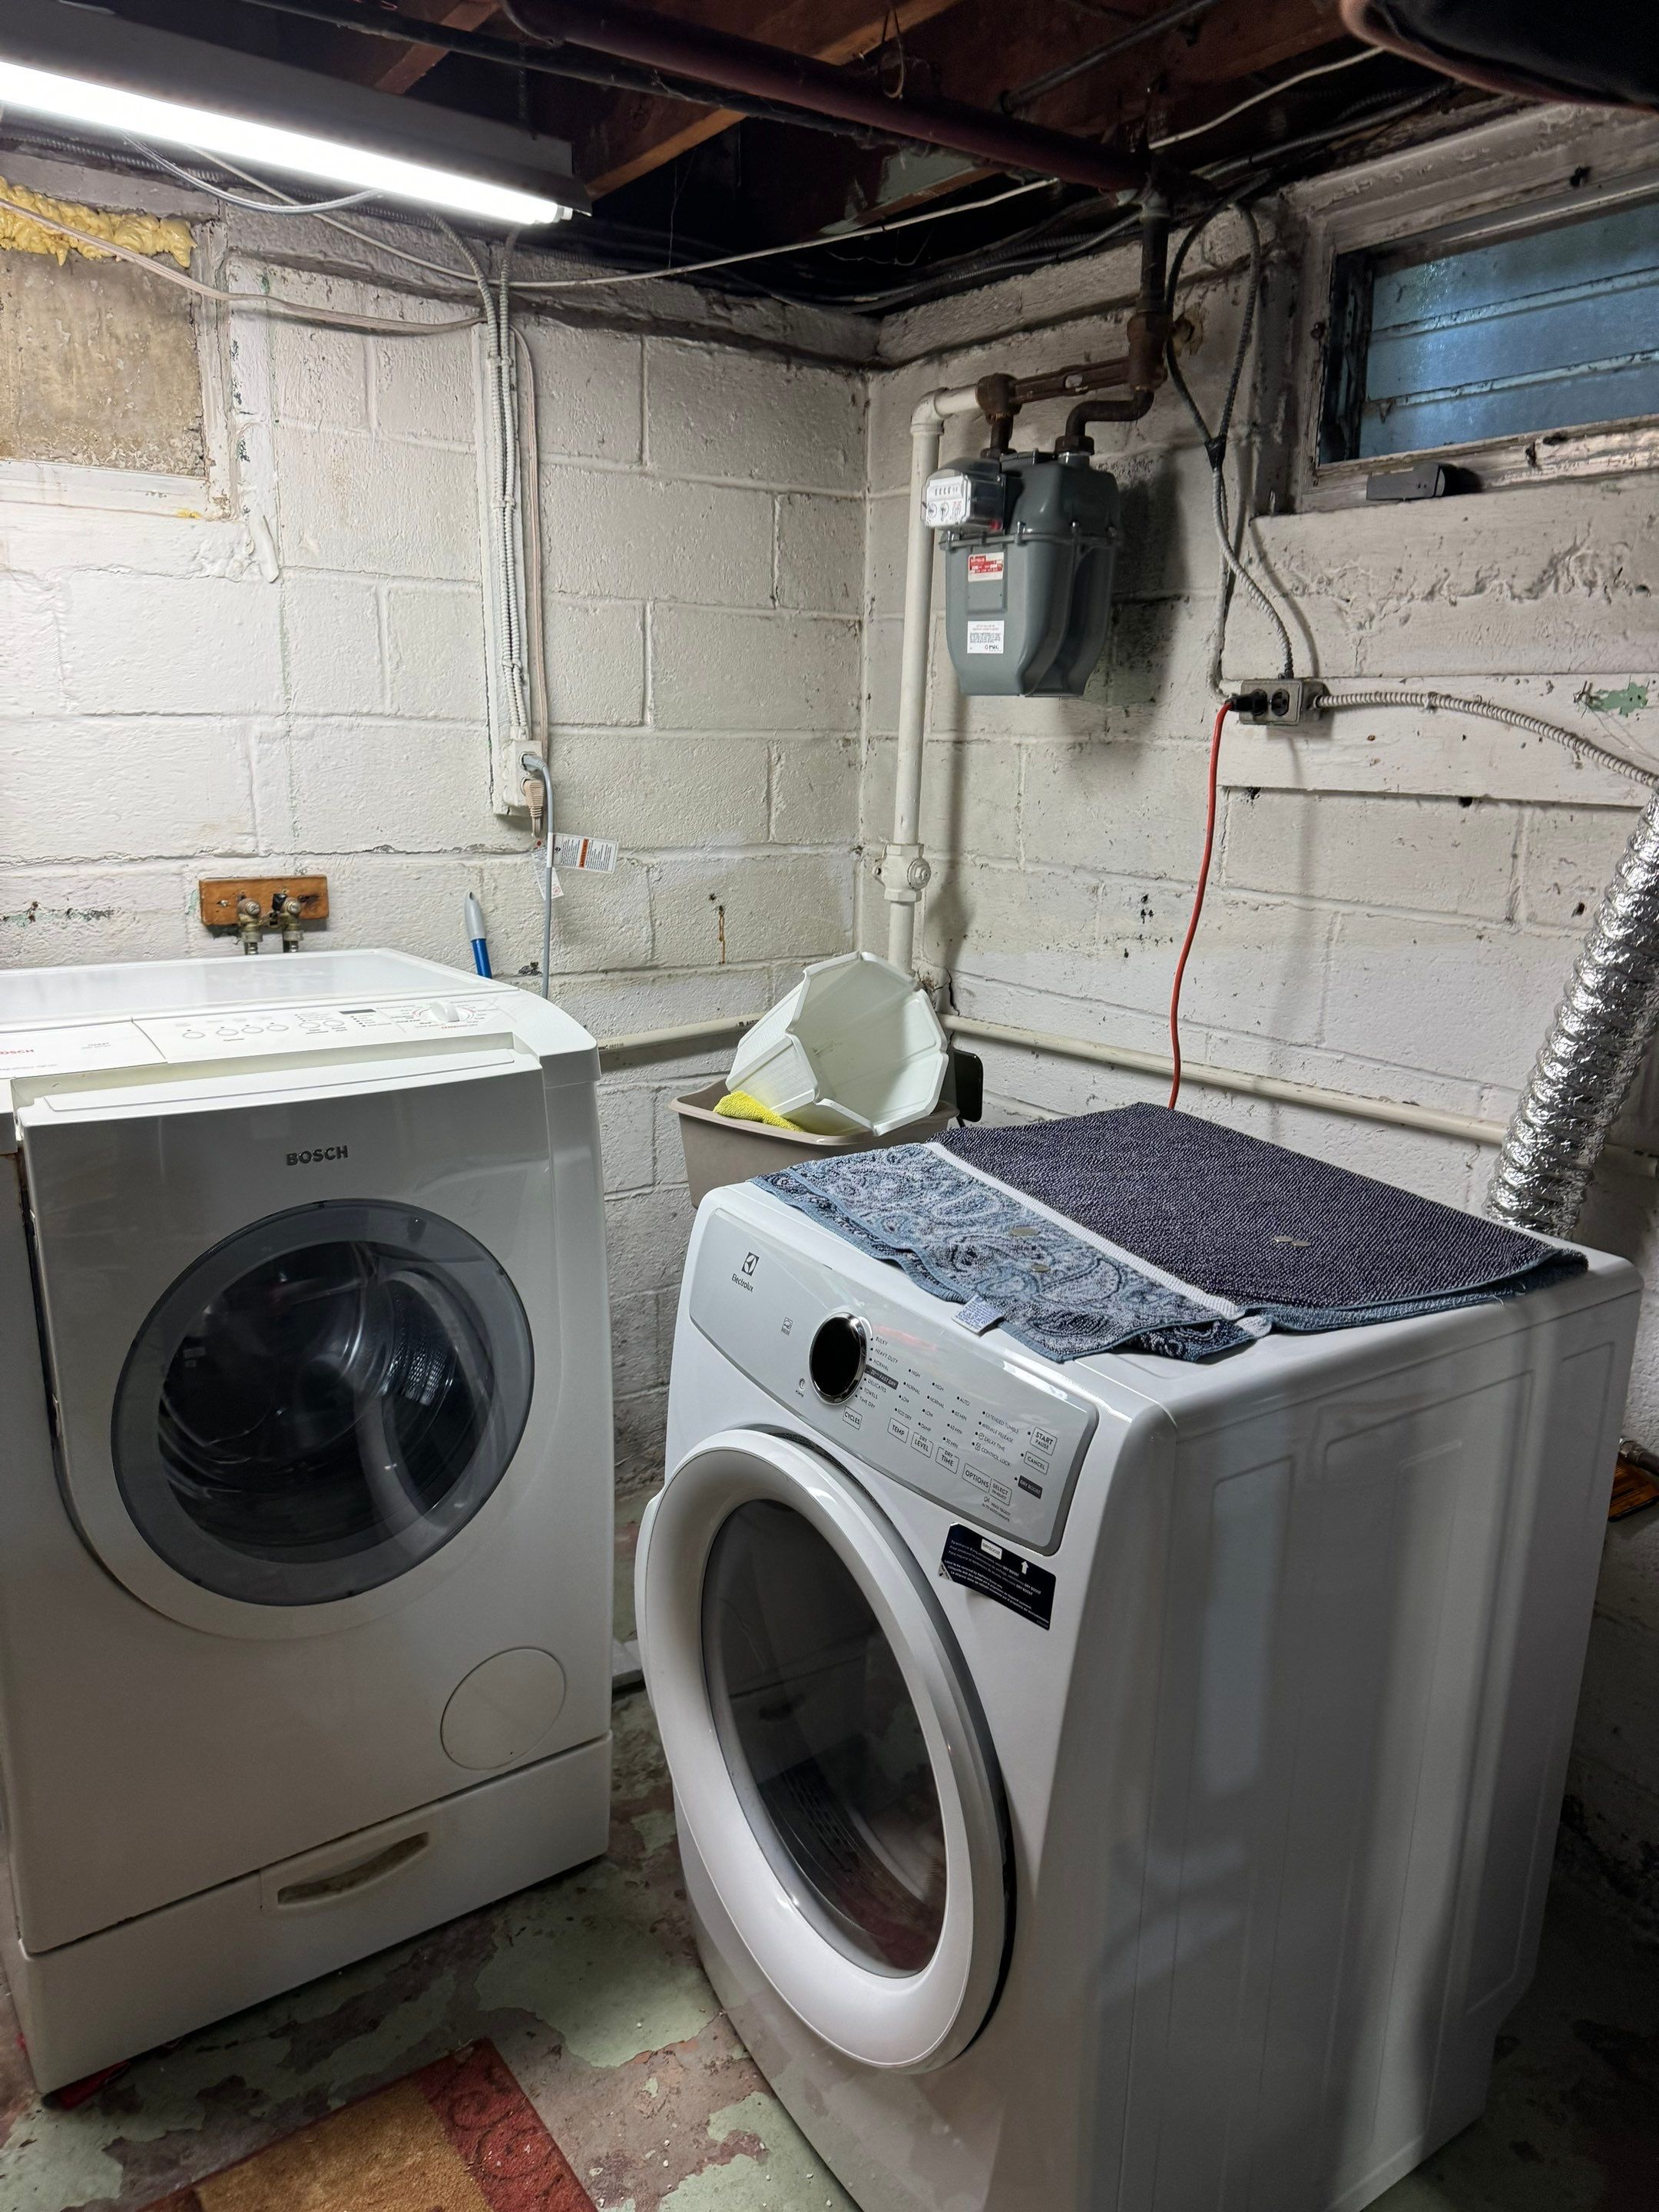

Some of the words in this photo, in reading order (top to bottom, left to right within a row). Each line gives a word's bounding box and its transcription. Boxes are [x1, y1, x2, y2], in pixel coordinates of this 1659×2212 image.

[286, 1145, 349, 1165] BOSCH
[731, 1273, 754, 1293] Electrolux
[875, 1349, 888, 1359] HEAVY
[887, 1356, 898, 1364] DUTY
[873, 1359, 889, 1372] NORMAL
[868, 1379, 886, 1393] DELICATES
[845, 1411, 860, 1425] CYCLES
[985, 1412, 1005, 1426] EXTENDED
[892, 1425, 905, 1435] TEMP
[915, 1439, 929, 1452] LEVEL
[1035, 1432, 1054, 1445] START
[1035, 1439, 1050, 1451] PAUSE
[944, 1449, 953, 1458] DRY
[981, 1446, 998, 1461] CONTROL
[941, 1455, 954, 1467] TIME
[1028, 1456, 1045, 1470] CANCEL
[965, 1470, 989, 1488] OPTIONS
[992, 1482, 1008, 1496] SELECT
